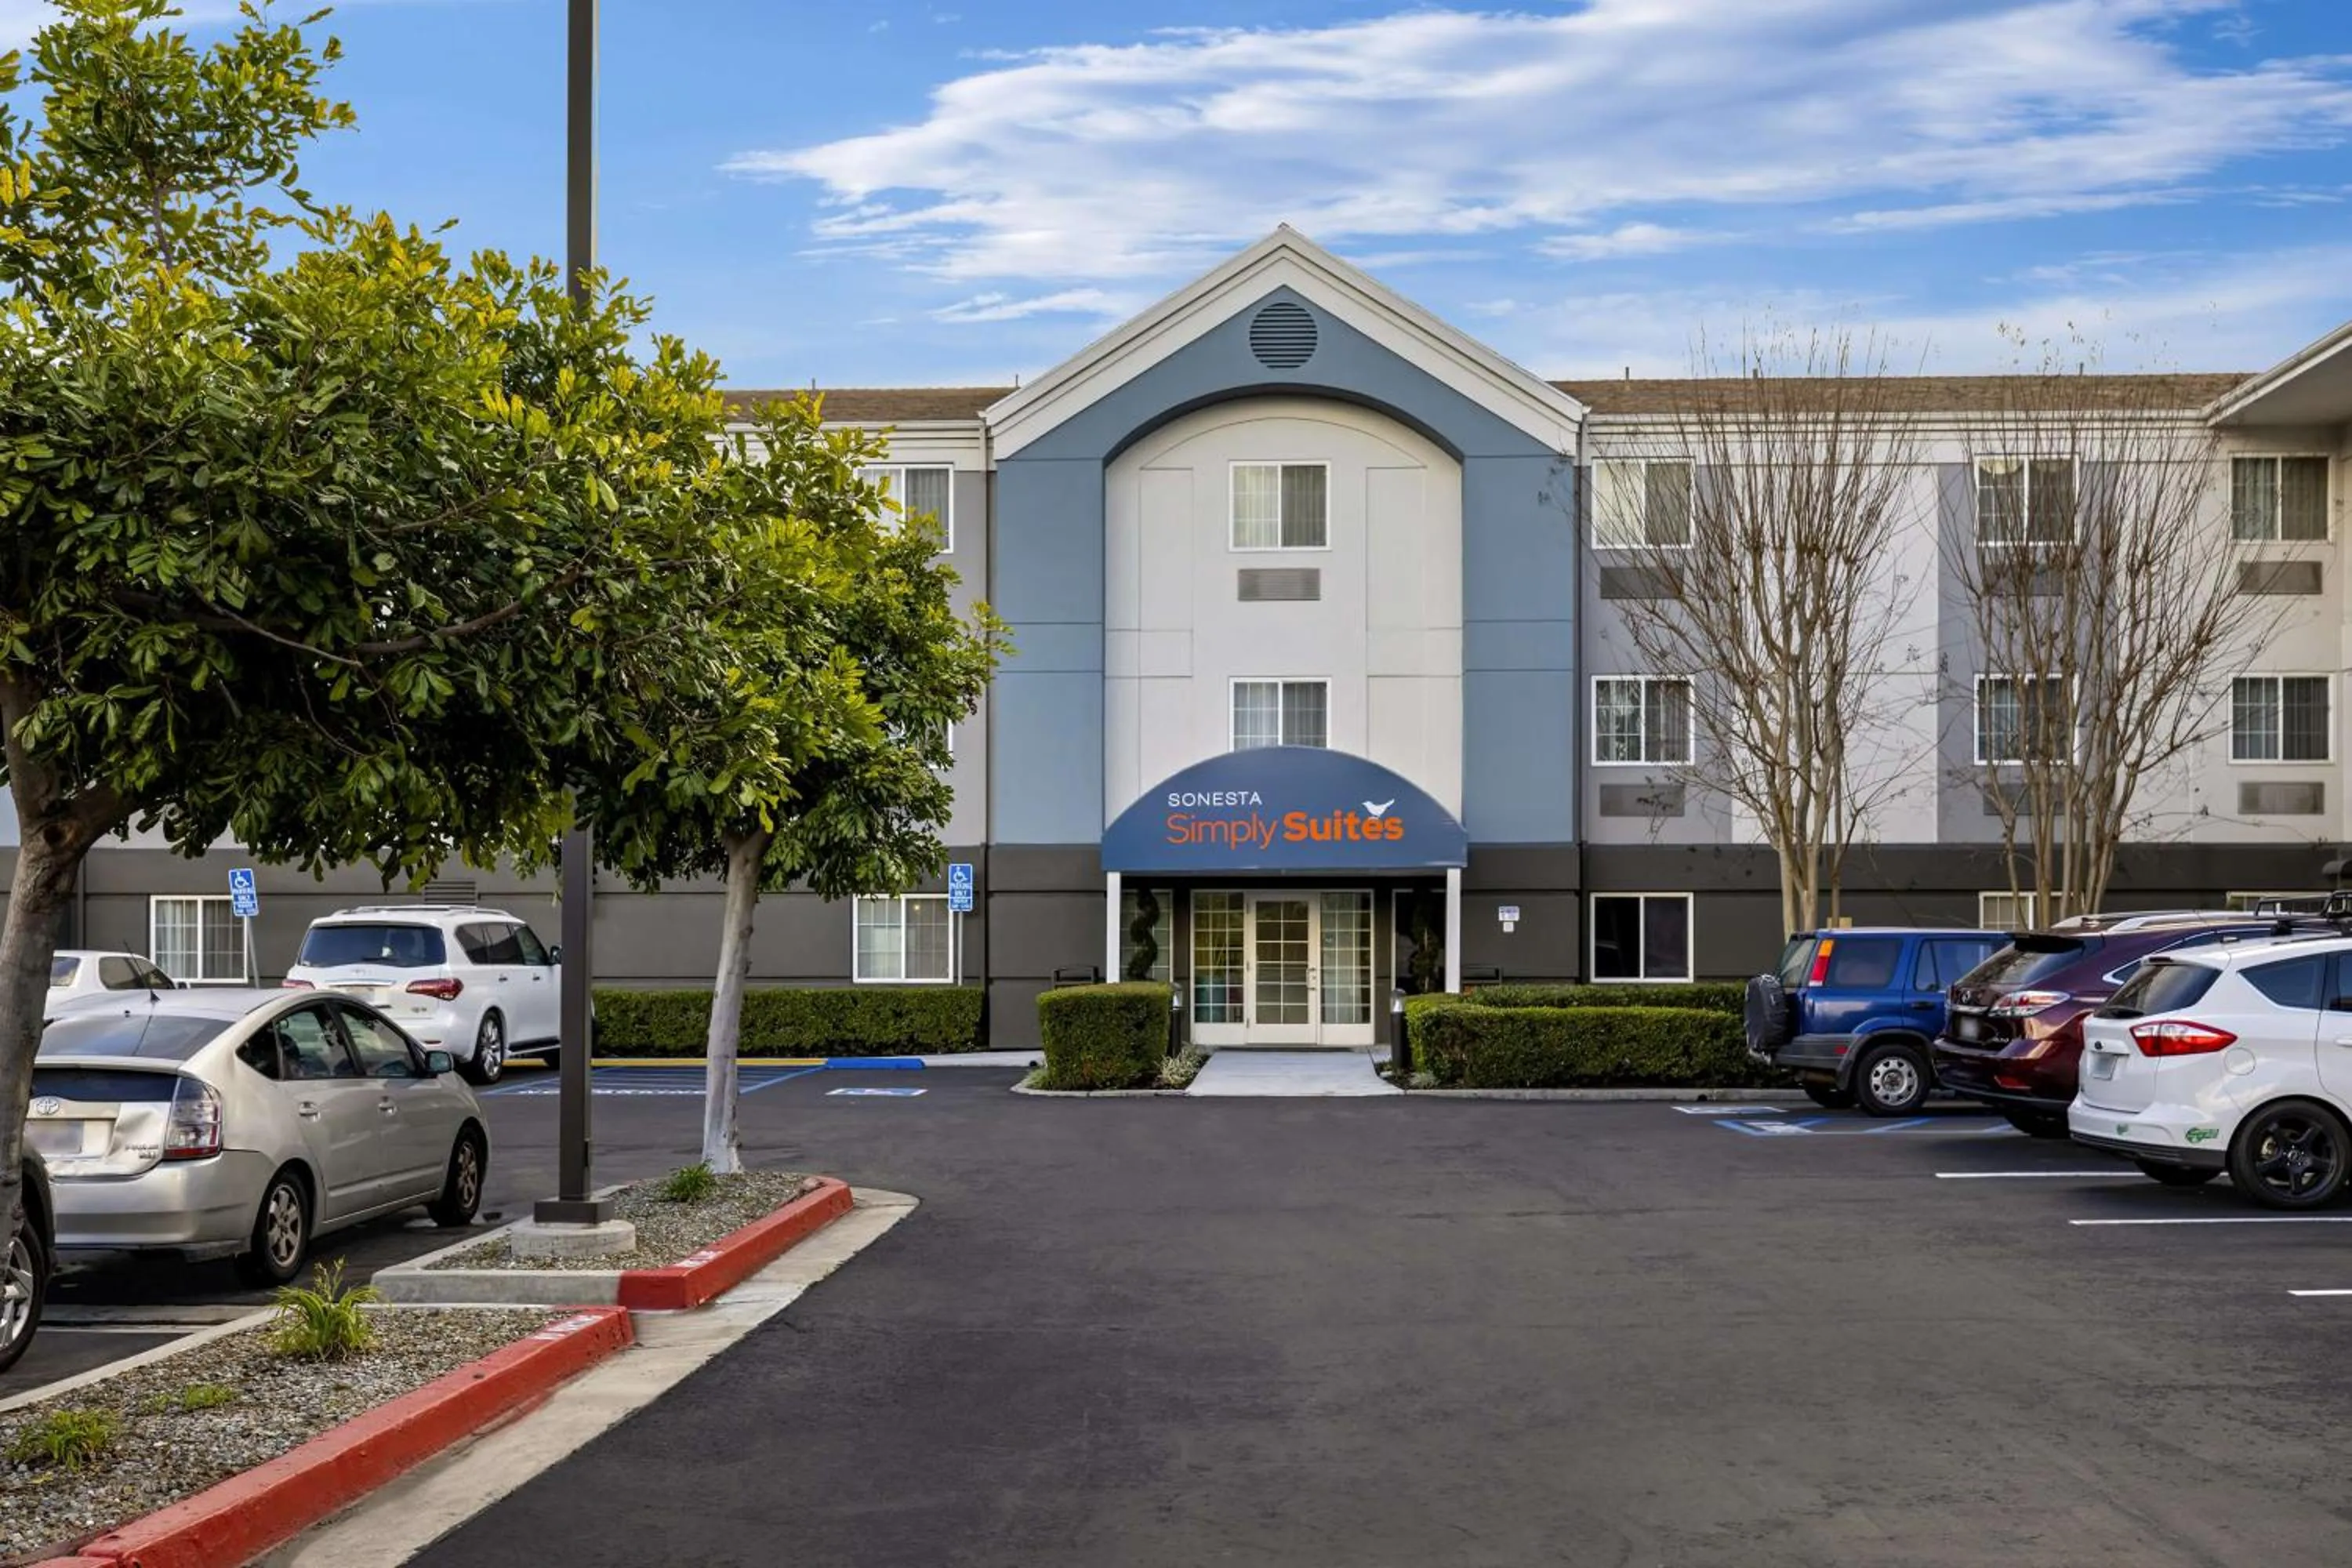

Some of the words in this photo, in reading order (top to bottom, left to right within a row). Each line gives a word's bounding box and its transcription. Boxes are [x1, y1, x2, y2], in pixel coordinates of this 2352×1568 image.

[1167, 792, 1262, 807] SONESTA
[1166, 812, 1277, 850] Simply
[1282, 809, 1405, 842] Suites
